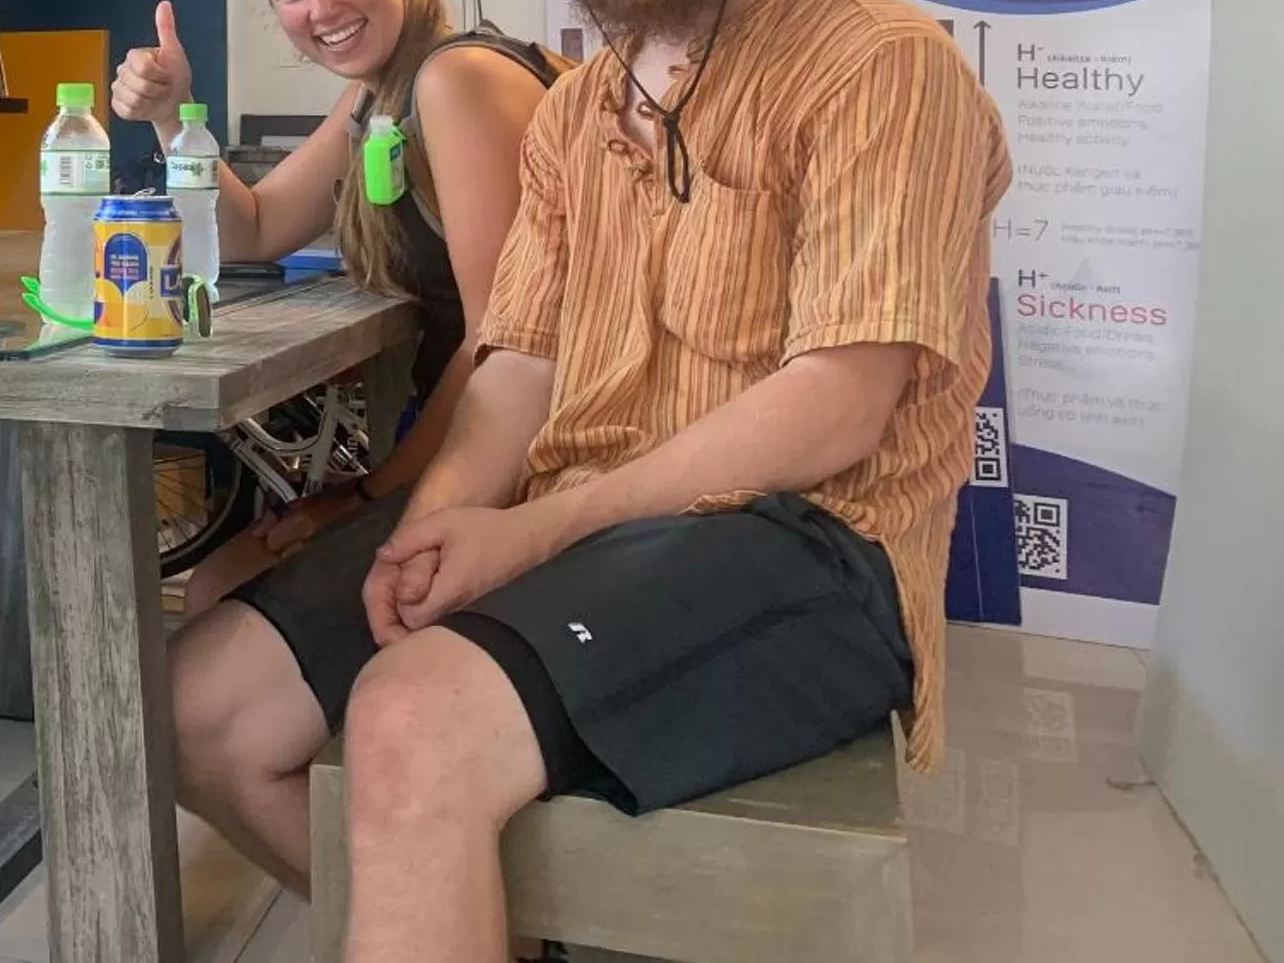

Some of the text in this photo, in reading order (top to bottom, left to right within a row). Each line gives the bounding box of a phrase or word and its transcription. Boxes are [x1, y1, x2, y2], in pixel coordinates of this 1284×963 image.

[1017, 67, 1145, 97] Healthy
[992, 218, 1050, 243] H=7
[1017, 293, 1169, 326] Sickness
